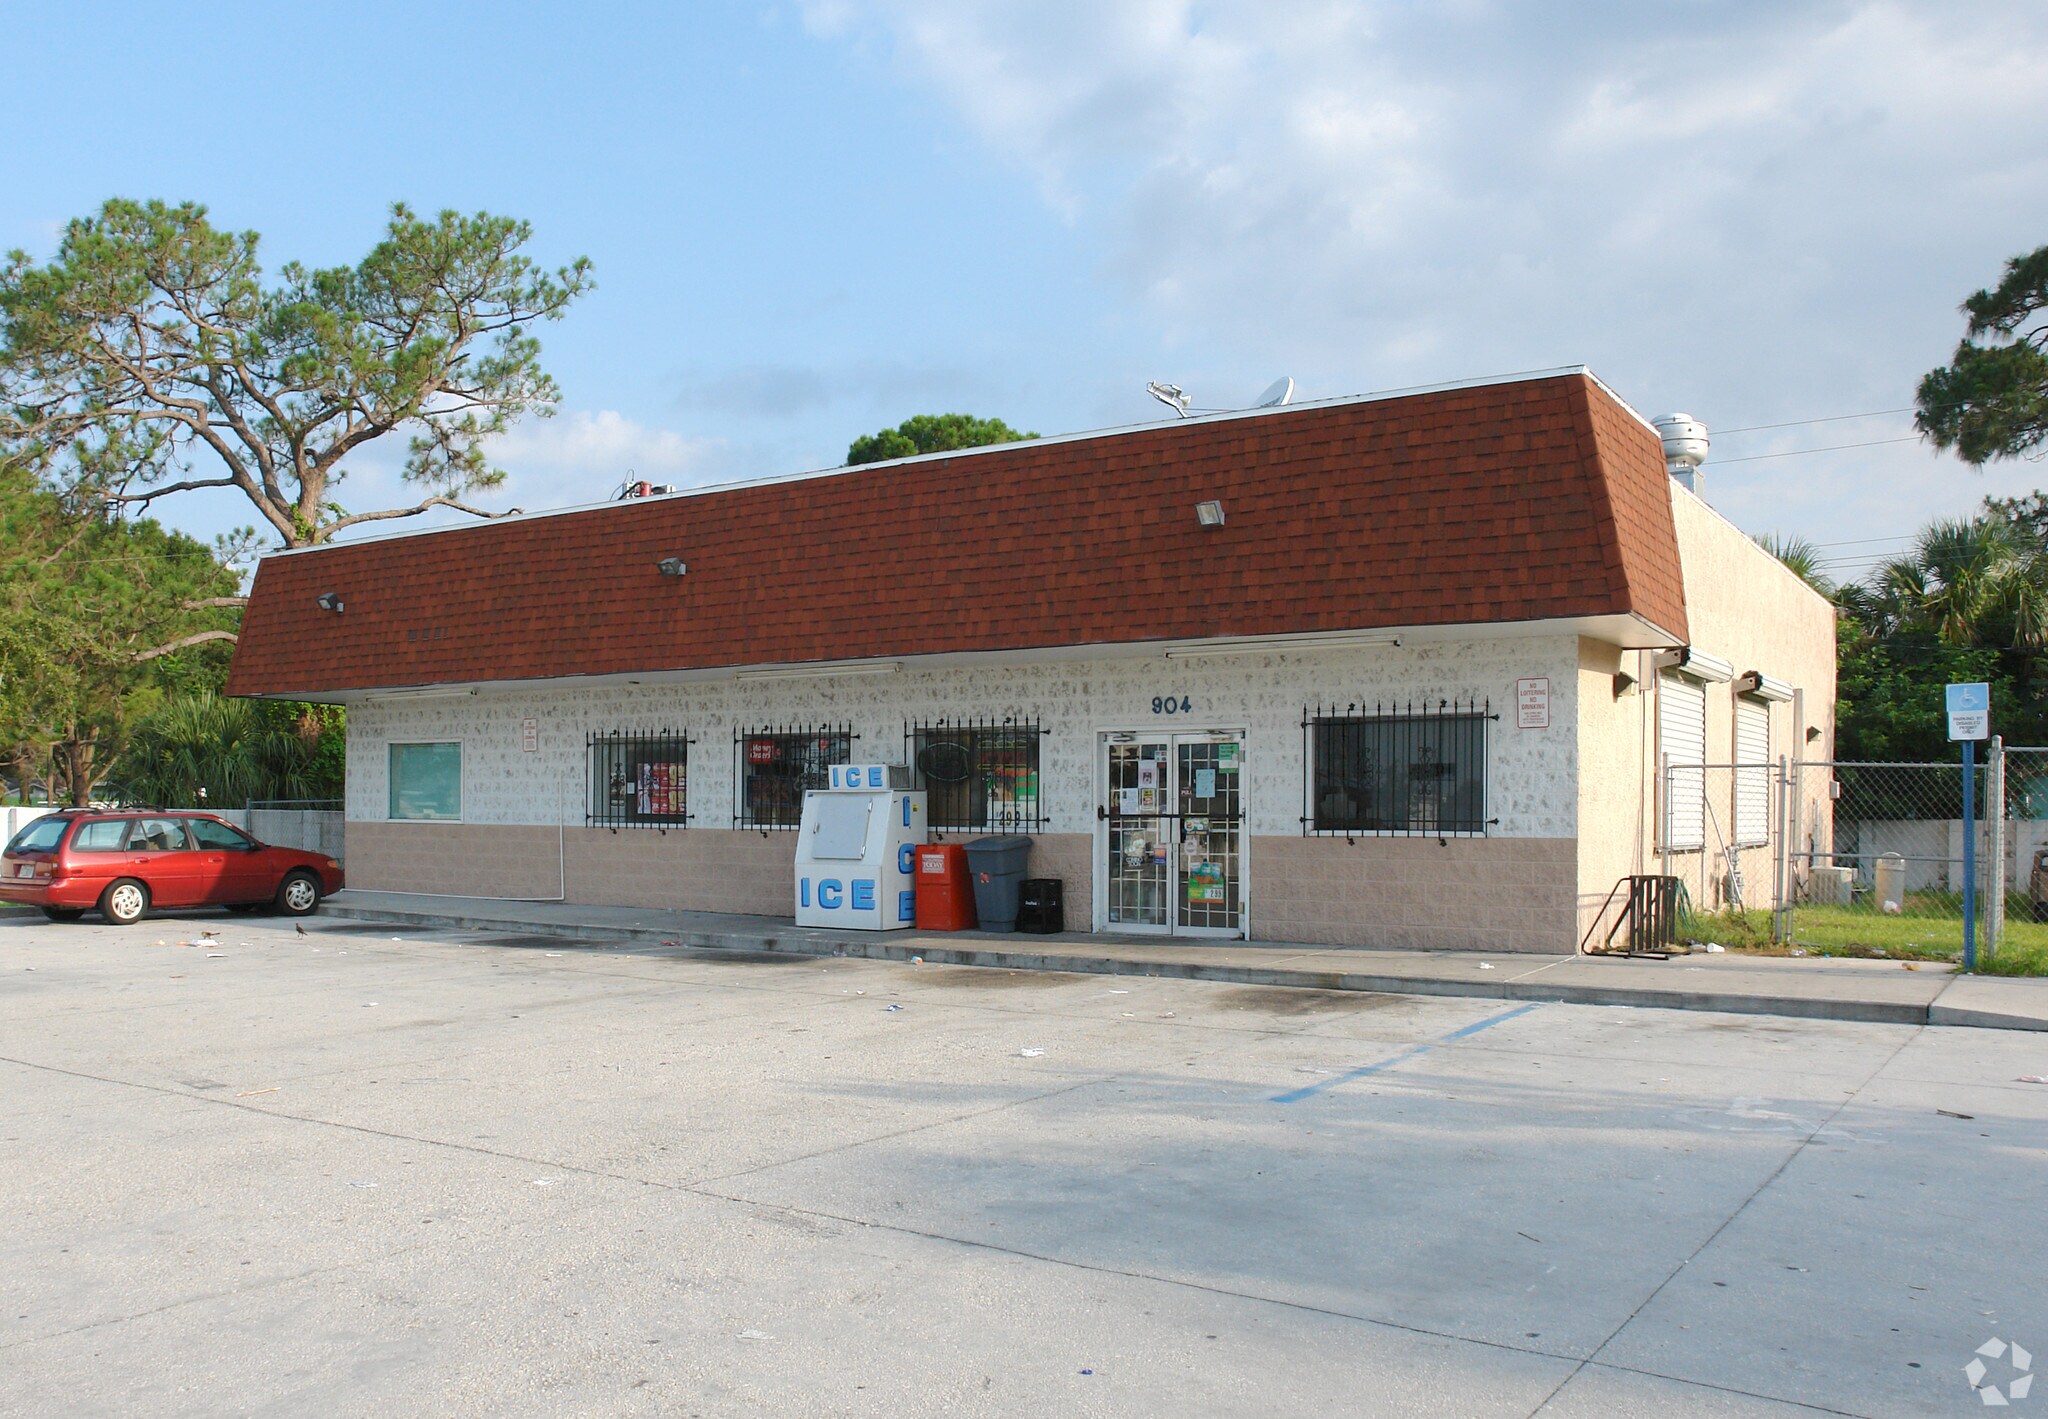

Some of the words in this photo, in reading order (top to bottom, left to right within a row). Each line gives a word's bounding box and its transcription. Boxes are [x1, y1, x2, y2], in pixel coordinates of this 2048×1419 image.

[1520, 689, 1546, 697] LOITERING
[1151, 695, 1192, 714] 904
[752, 744, 774, 753] Money
[832, 767, 883, 788] ICE
[897, 796, 916, 922] ICE
[800, 877, 876, 911] ICE
